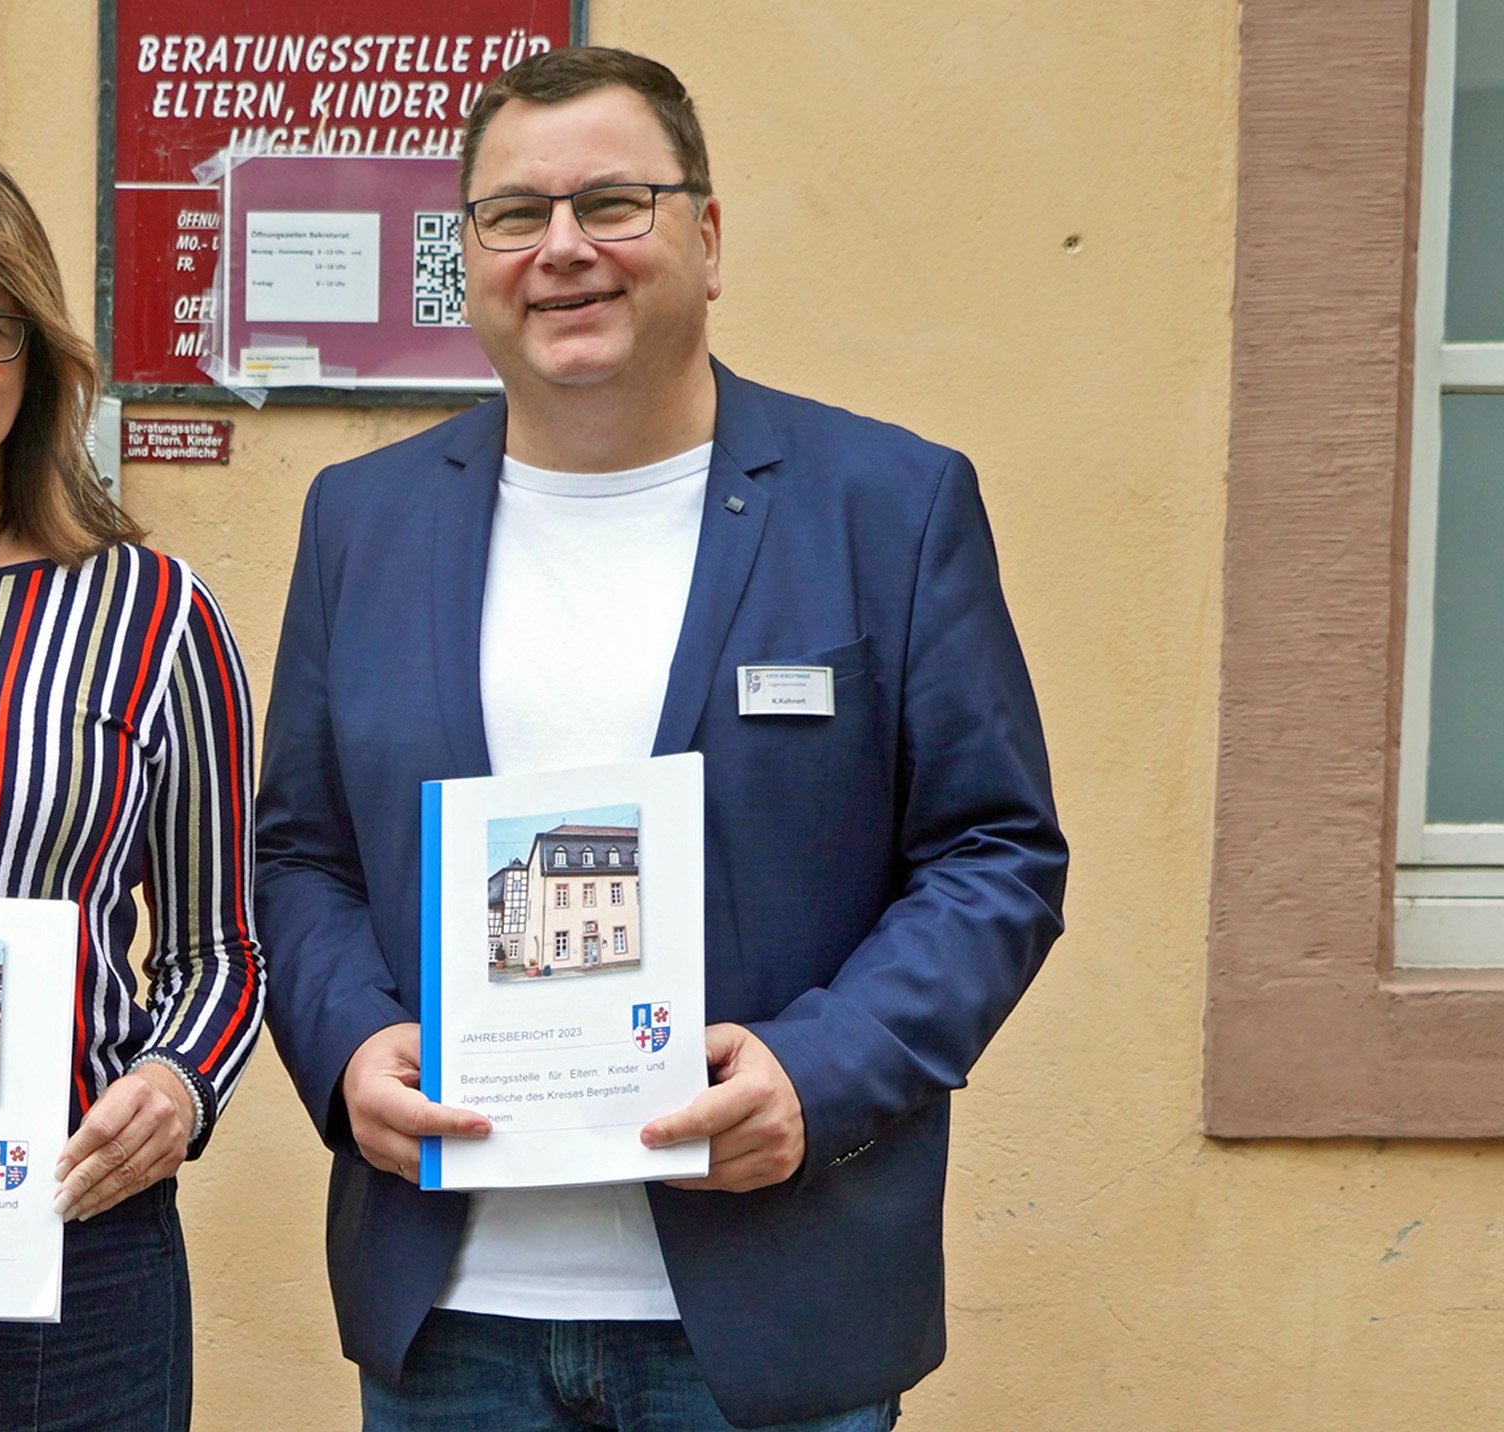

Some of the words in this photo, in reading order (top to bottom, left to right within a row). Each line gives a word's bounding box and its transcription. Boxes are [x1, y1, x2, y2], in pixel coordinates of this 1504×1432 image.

[137, 34, 473, 75] BERATUNGSSTELLE
[152, 81, 295, 124] ELTERN,
[309, 80, 450, 121] KINDER
[176, 256, 195, 272] FR.
[174, 332, 209, 357] MI.
[128, 421, 214, 435] Beratungsstelle
[128, 434, 144, 445] für
[148, 434, 183, 447] Eltern,
[187, 435, 223, 446] Kinder
[127, 446, 149, 457] und
[152, 447, 218, 460] Jugendliche
[460, 1029, 555, 1043] JAHRESBERICHT
[558, 1027, 583, 1039] 2023
[460, 1072, 540, 1086] Beratungsstelle
[548, 1071, 562, 1081] für
[607, 1064, 639, 1075] Kinder
[646, 1061, 666, 1072] und
[460, 1092, 523, 1105] Jugendliche
[525, 1090, 545, 1101] des
[547, 1089, 585, 1100] Kreises
[587, 1084, 640, 1098] Bergstraße
